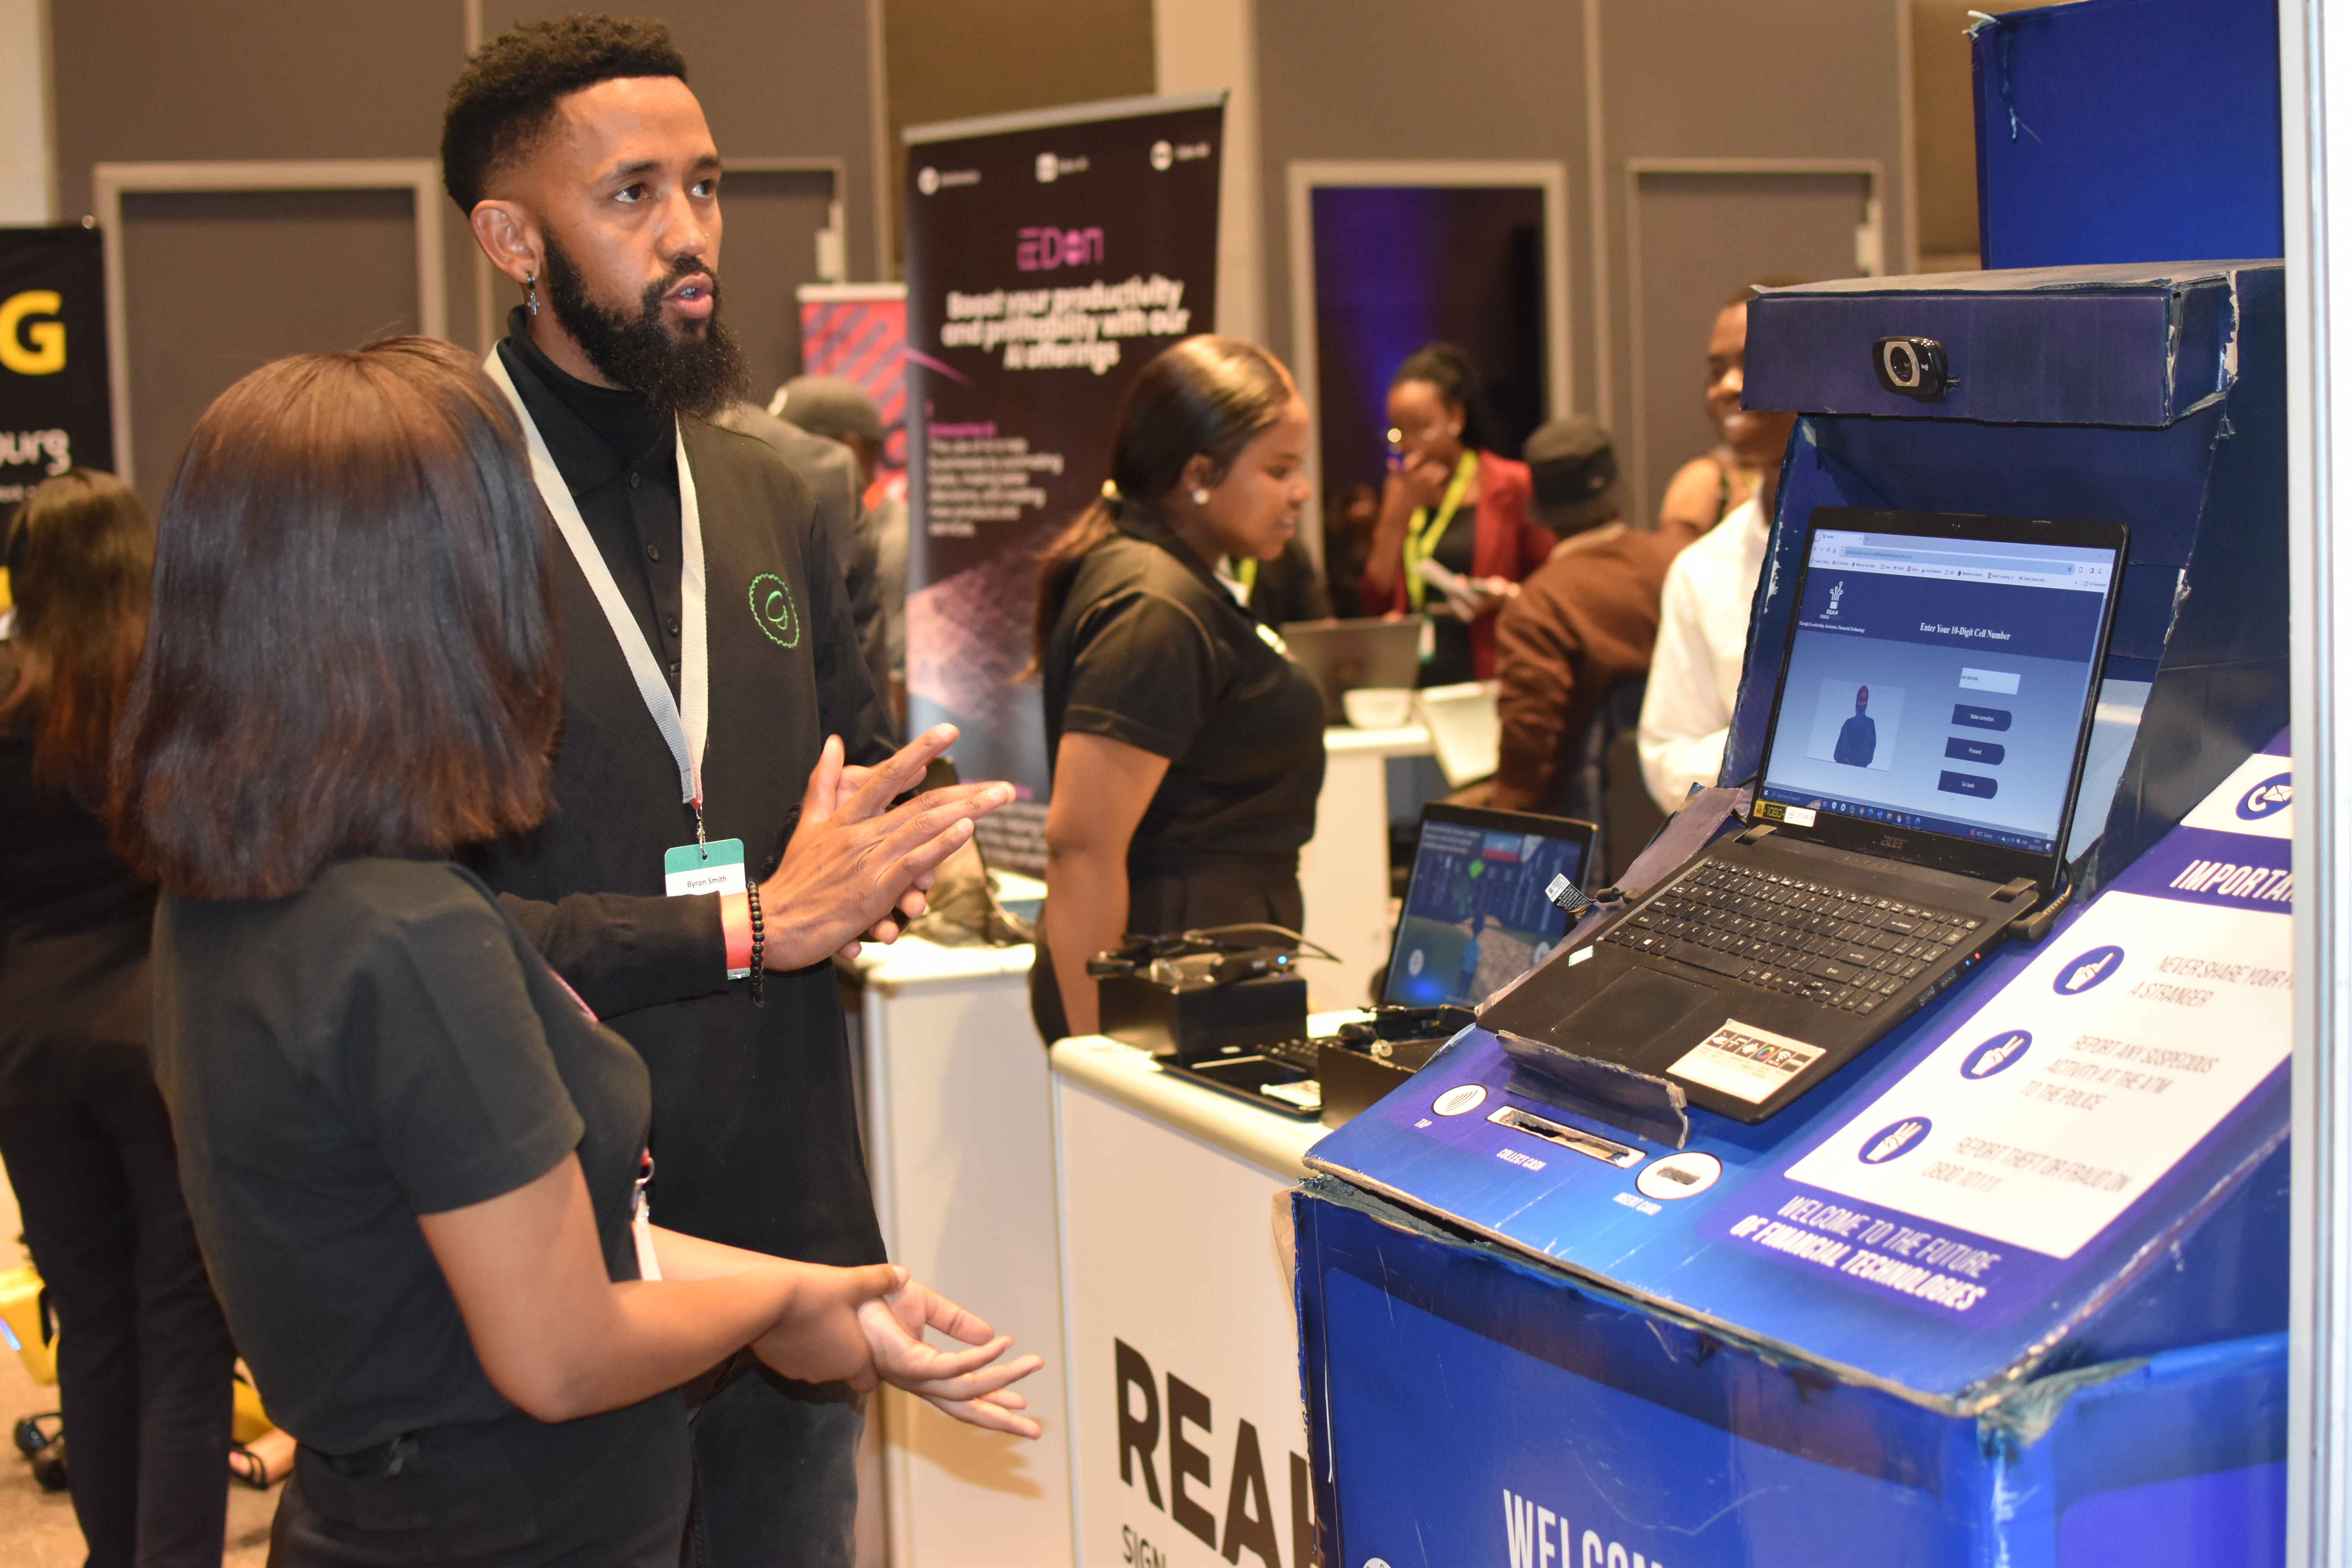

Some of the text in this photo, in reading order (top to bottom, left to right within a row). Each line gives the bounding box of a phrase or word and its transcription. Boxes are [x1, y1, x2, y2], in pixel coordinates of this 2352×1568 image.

[946, 273, 1184, 319] Boost your productivity
[940, 309, 1191, 353] and profitability with our
[1025, 340, 1121, 376] offerings
[1920, 622, 2011, 640] Enter Your 10-Digit Cell Number
[1767, 807, 1782, 818] 1080
[1881, 835, 1908, 849] acer
[687, 875, 727, 889] Byron Smith
[2153, 956, 2204, 976] NEVER
[2197, 961, 2250, 982] SHARE
[2243, 967, 2286, 987] YOUR
[2126, 981, 2214, 1007] A STRANGER
[2069, 1034, 2122, 1056] REPORT
[2114, 1043, 2149, 1060] ANY
[2043, 1058, 2174, 1094] ACTIVITY AT THE ATM
[2020, 1080, 2107, 1111] TO THE POLICE
[1414, 1118, 1432, 1129] TAP
[1496, 1149, 1546, 1171] COLLECT CASH
[1922, 1161, 1965, 1182] 0800
[1951, 1136, 2134, 1191] REPORT THEFT OR FRAUD ON
[1777, 1195, 2002, 1279] WELCOME TO THE FUTURE
[1730, 1214, 1987, 1311] OF FINANCIAL TECHNOLOGIES
[1503, 1488, 1664, 1568] WEL
[1123, 1523, 1166, 1568] SIGN
